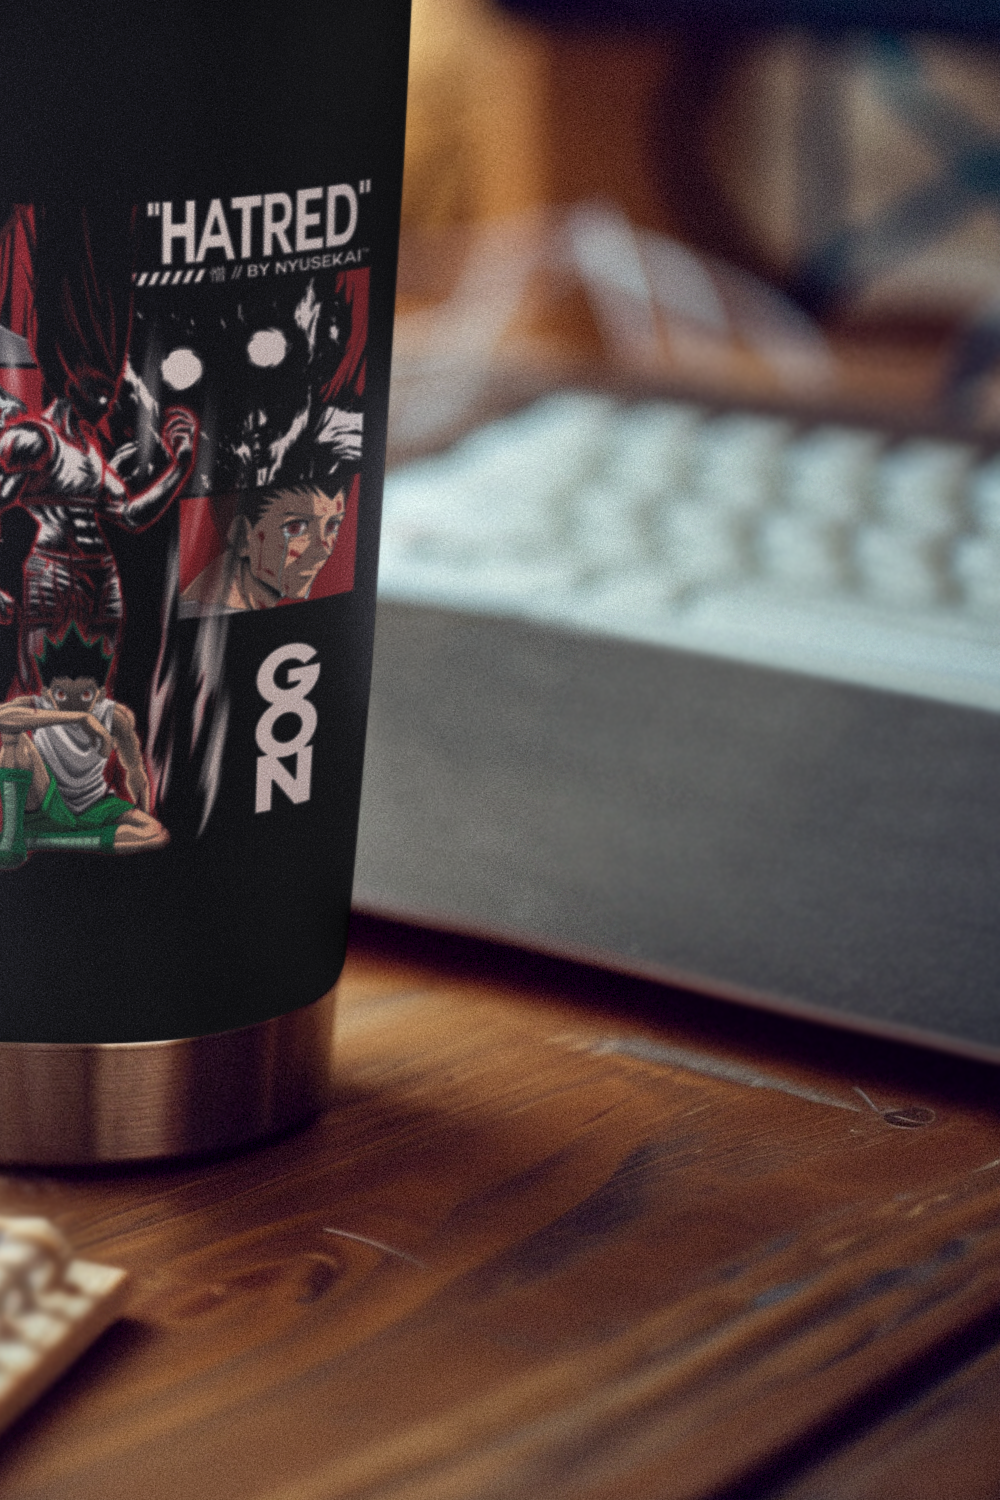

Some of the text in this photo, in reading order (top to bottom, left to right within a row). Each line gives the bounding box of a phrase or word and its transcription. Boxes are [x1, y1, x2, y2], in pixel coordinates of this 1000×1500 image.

[147, 179, 372, 265] "HATRED"
[247, 263, 270, 278] BY
[254, 642, 321, 814] GON
